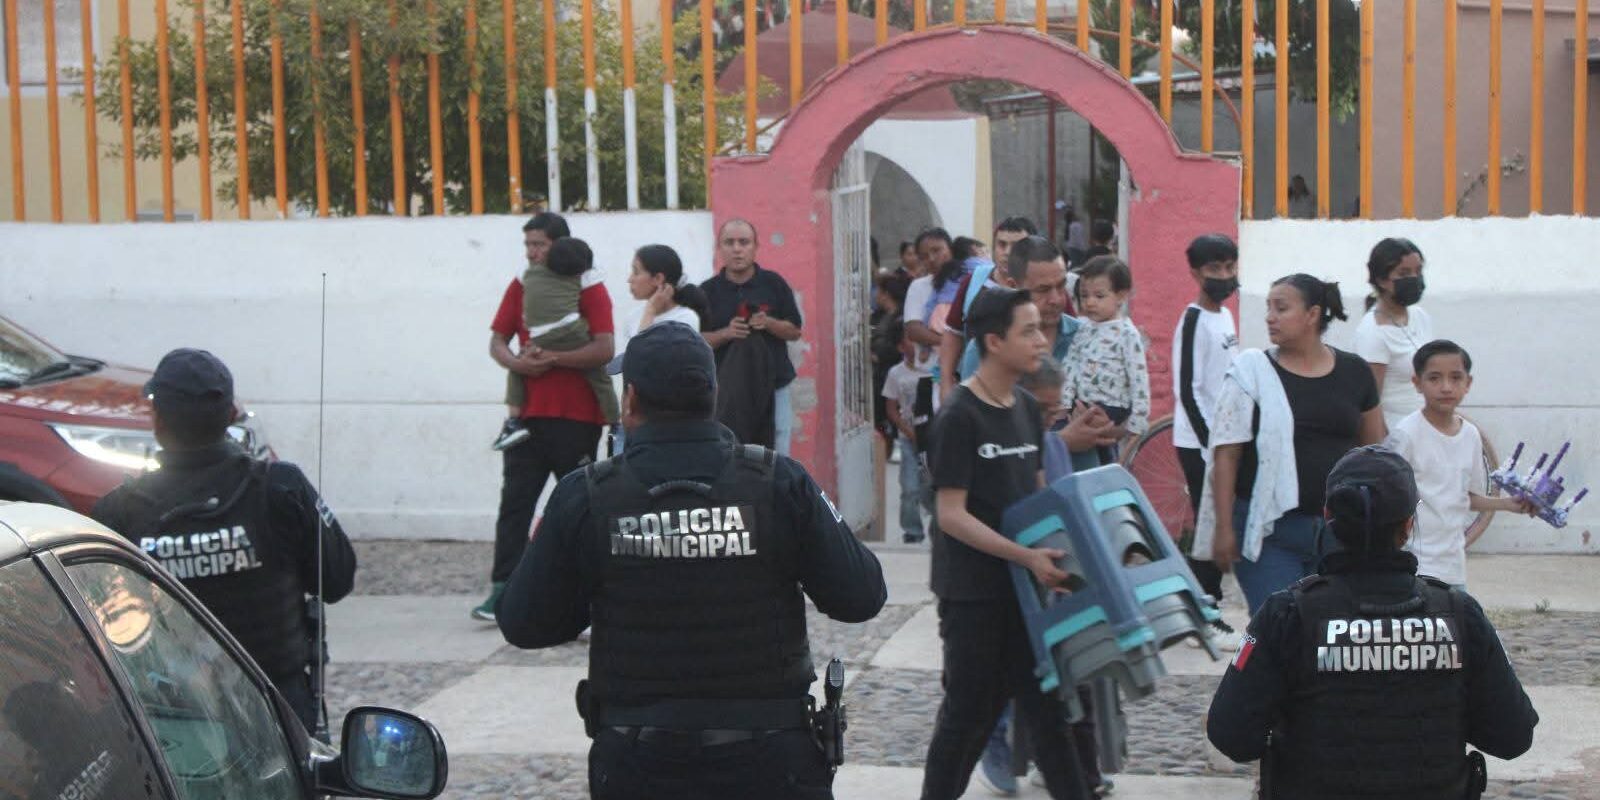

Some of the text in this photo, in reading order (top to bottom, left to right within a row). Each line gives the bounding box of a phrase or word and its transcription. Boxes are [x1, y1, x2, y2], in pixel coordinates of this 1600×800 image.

[618, 506, 745, 535] POLICIA
[141, 526, 251, 557] POLICIA
[611, 531, 757, 558] MUNICIPAL
[159, 547, 262, 579] NICIPAL
[1327, 617, 1454, 644] POLICIA
[1317, 643, 1463, 672] MUNICIPAL
